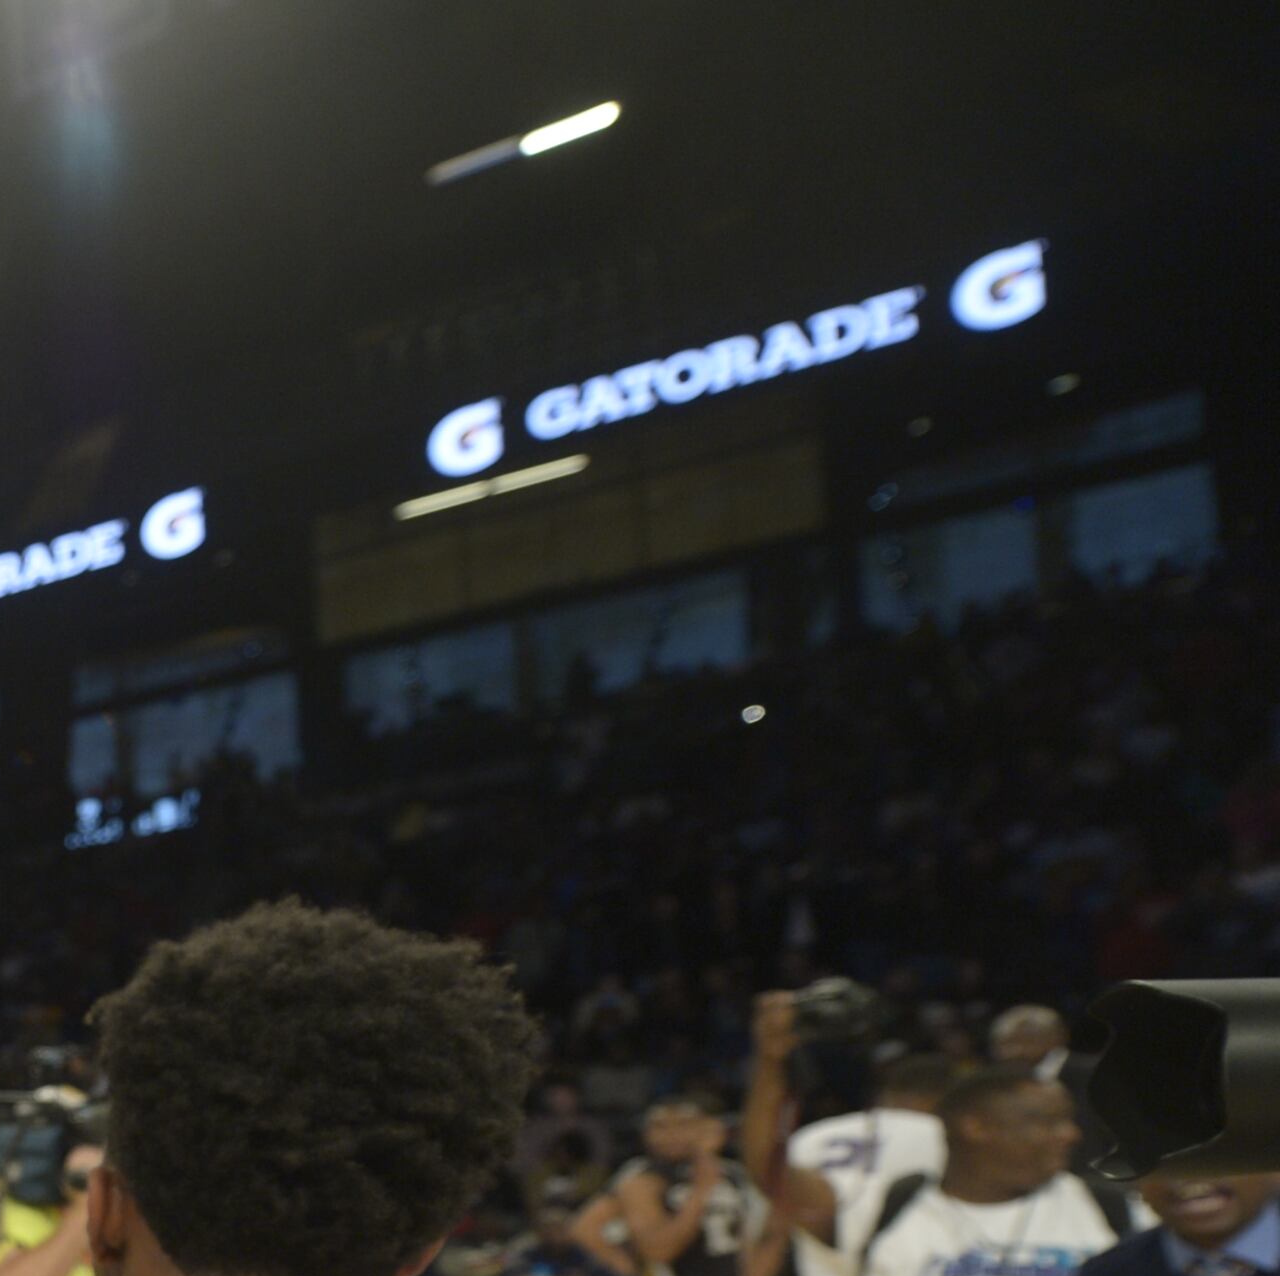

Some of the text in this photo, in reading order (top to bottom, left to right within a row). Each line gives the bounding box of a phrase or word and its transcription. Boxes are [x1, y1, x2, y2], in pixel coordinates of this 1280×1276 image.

[424, 239, 1049, 474] G GATORADE G
[139, 486, 207, 561] G
